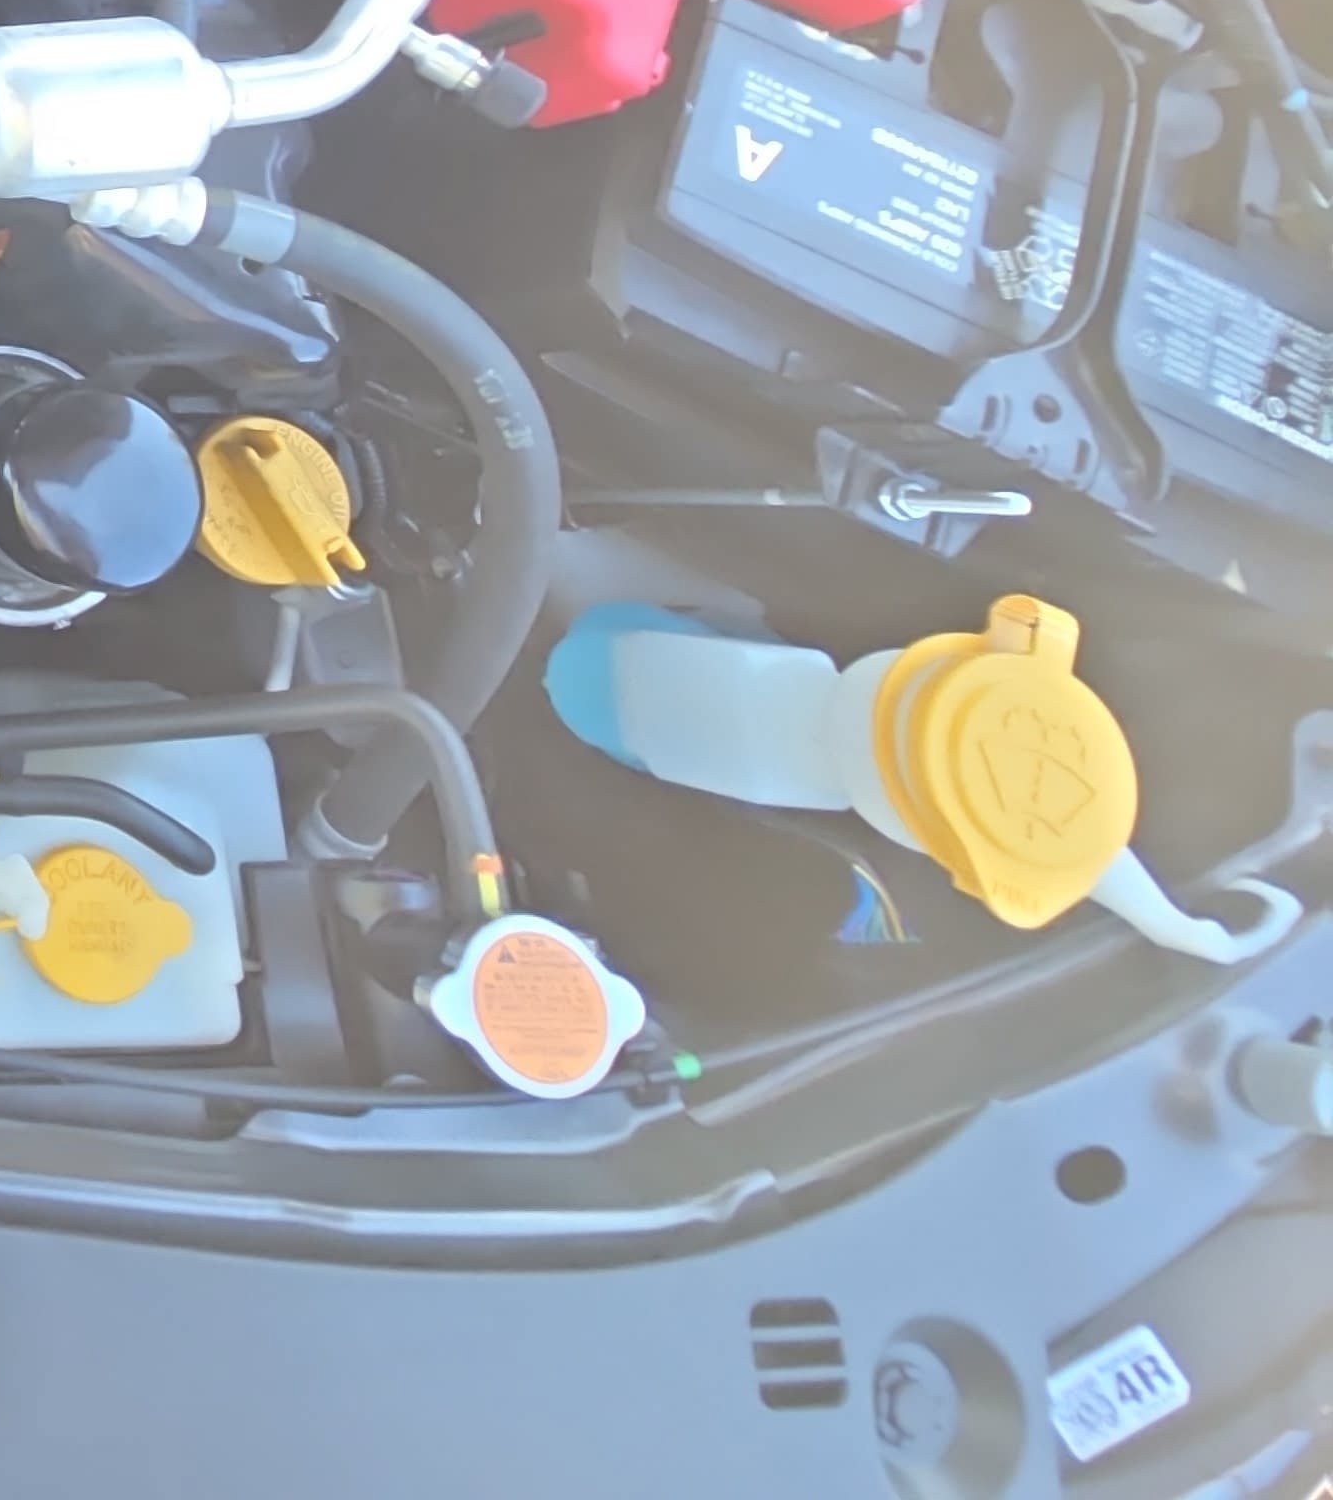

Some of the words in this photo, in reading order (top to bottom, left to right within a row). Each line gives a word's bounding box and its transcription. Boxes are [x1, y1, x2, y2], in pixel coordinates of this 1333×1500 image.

[735, 124, 784, 182] A
[276, 426, 336, 488] ENGINE
[47, 856, 153, 906] OOLANT
[1115, 1354, 1174, 1405] 4R
